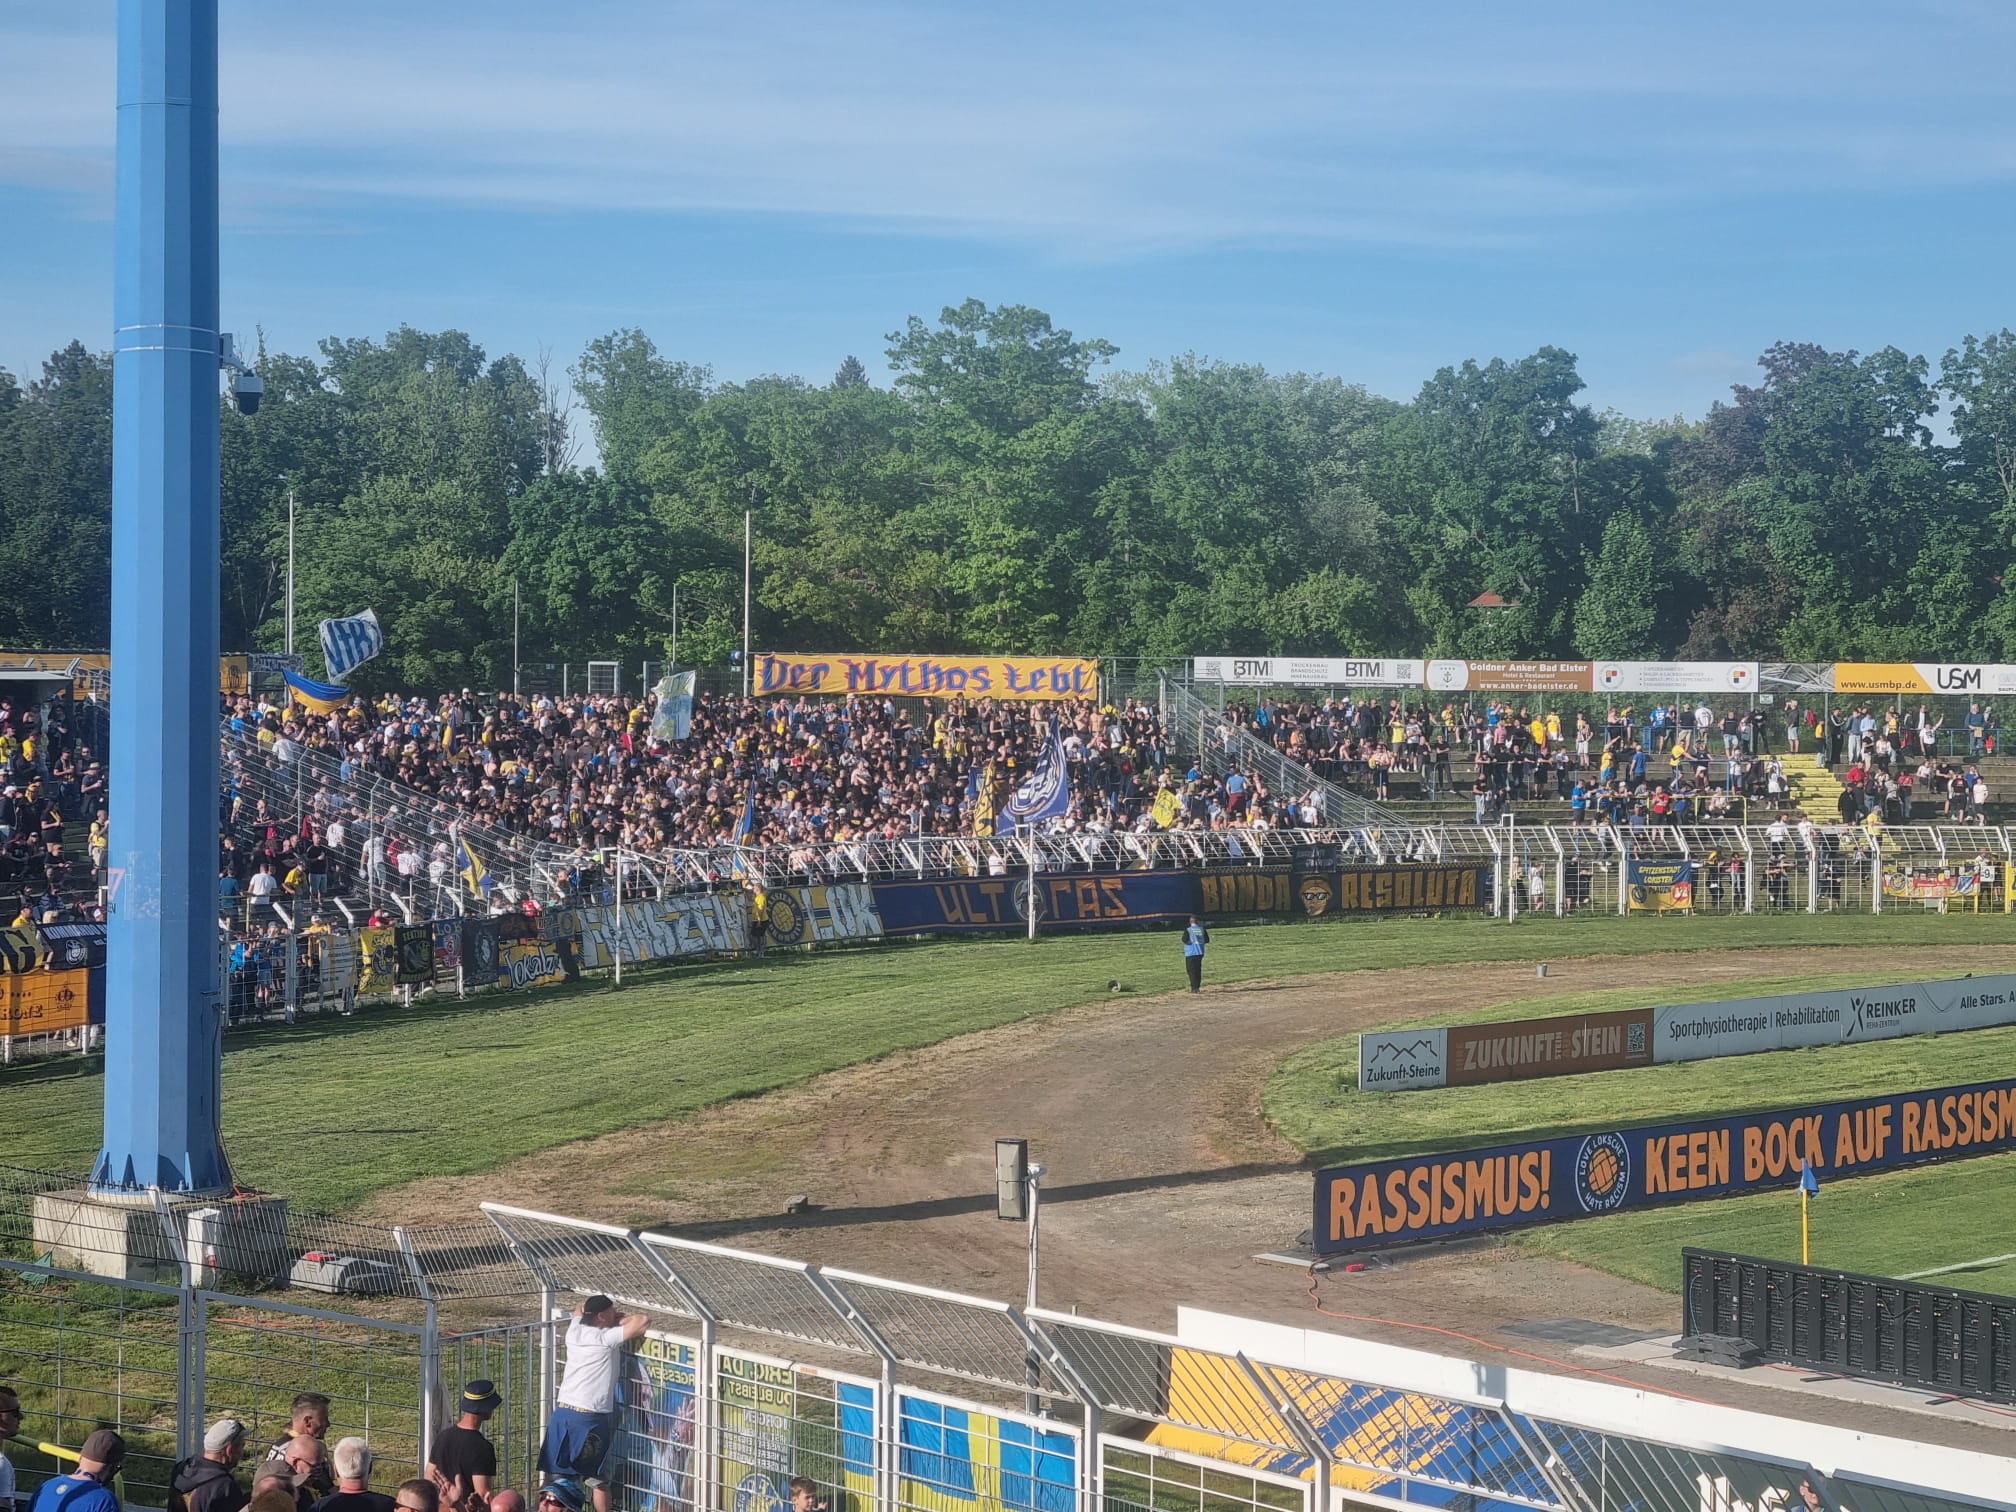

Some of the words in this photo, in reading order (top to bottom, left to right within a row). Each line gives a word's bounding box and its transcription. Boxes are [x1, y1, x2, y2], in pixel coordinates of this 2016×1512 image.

[758, 655, 830, 691] Der
[838, 658, 993, 696] Mythos
[1003, 660, 1095, 696] Lebt
[1234, 660, 1268, 676] BTM
[1346, 662, 1380, 677] BTM
[1470, 663, 1505, 671] Goldner
[1509, 664, 1536, 672] Anker
[1540, 664, 1557, 672] Bad
[1560, 664, 1588, 672] Elster
[1480, 682, 1578, 690] www.anker-badelster.de
[1840, 680, 1917, 691] www.usmbp.de
[1937, 668, 1981, 689] USM
[1200, 873, 1291, 913] BANDA
[1341, 869, 1477, 910] RESOLUTA
[1866, 998, 1916, 1019] REINKER
[1960, 996, 1978, 1009] Alle
[1980, 994, 2006, 1007] Stars.
[1669, 1012, 1768, 1042] Sportphysiotherapie
[1775, 1006, 1840, 1029] Rehabilitation
[1463, 1032, 1555, 1071] ZUKUNFT
[1571, 1026, 1621, 1058] STEIN
[1367, 1063, 1440, 1083] Zukunft-Steine
[1593, 1135, 1625, 1157] LOKSCHE
[1646, 1128, 1730, 1195] KEEN
[1743, 1114, 1825, 1182] BOCK
[1834, 1104, 1892, 1168] AUF
[1579, 1145, 1593, 1175] LOVE
[1330, 1150, 1551, 1241] RASSISMUS!
[1584, 1191, 1604, 1210] HATE
[1605, 1171, 1626, 1209] RACISM
